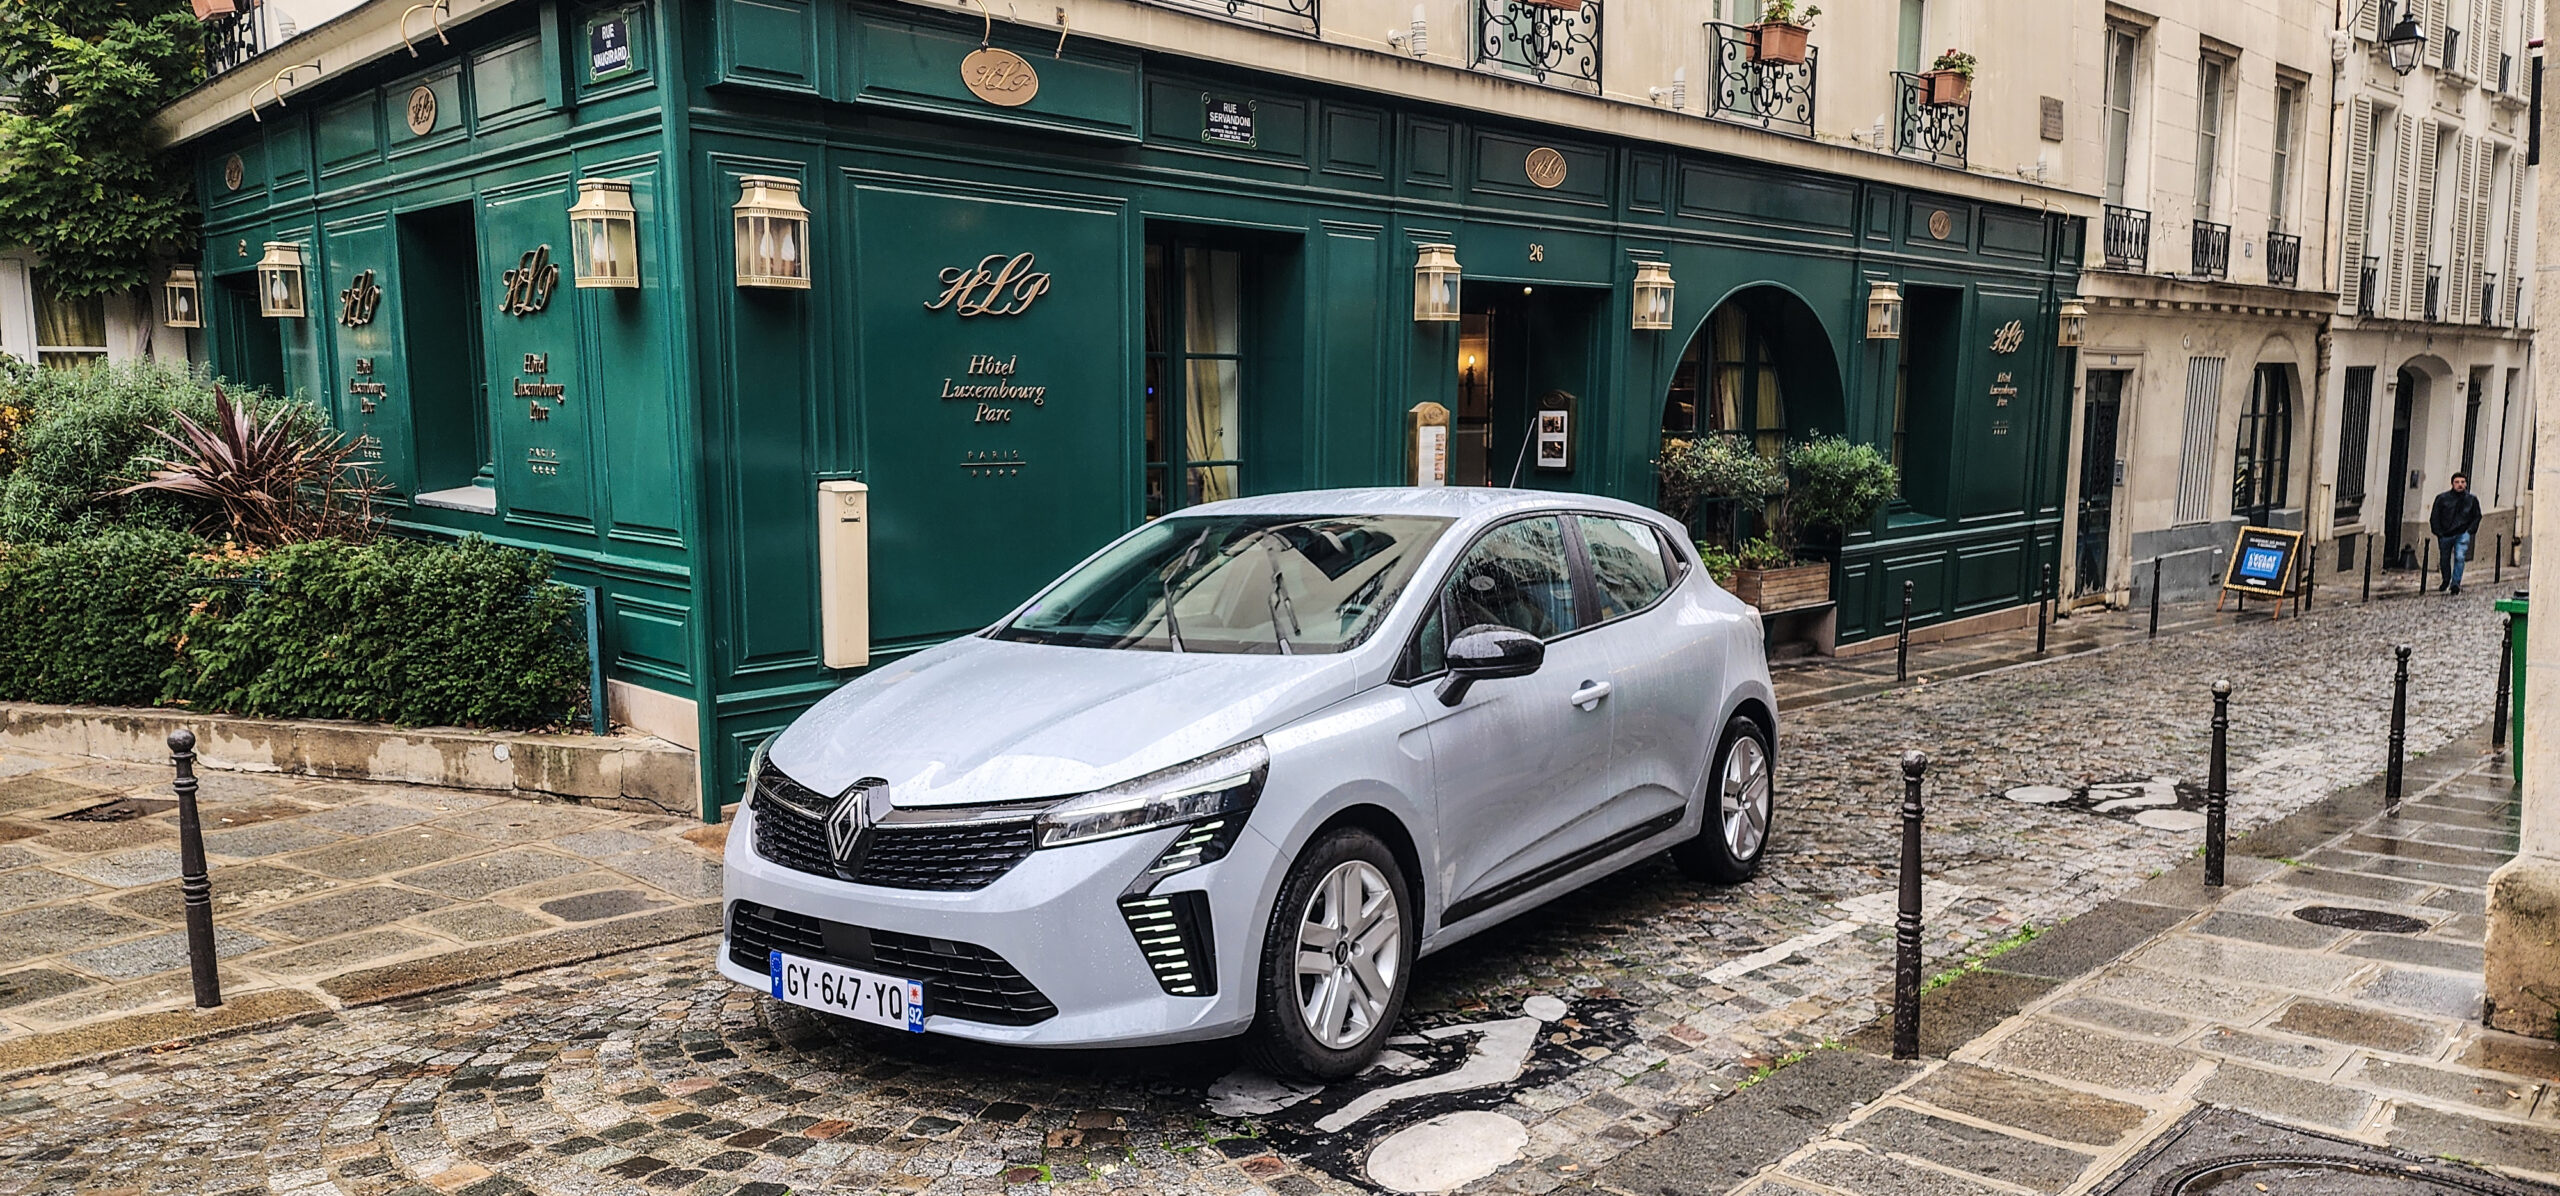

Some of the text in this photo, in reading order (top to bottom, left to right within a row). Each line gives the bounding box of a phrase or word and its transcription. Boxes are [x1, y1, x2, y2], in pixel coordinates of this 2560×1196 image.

[602, 24, 615, 40] RUE
[594, 46, 626, 68] VAUGIRARD
[1223, 102, 1238, 114] RUE
[1209, 111, 1251, 128] SERVANDONI
[1529, 243, 1544, 262] 26
[967, 354, 1017, 376] Hôtel
[940, 377, 1046, 406] Luxembourg
[974, 402, 1012, 423] Parc
[967, 449, 1019, 460] PARIS
[774, 977, 780, 986] F
[787, 964, 902, 1020] GY-647-YQ
[909, 1007, 922, 1025] 92
